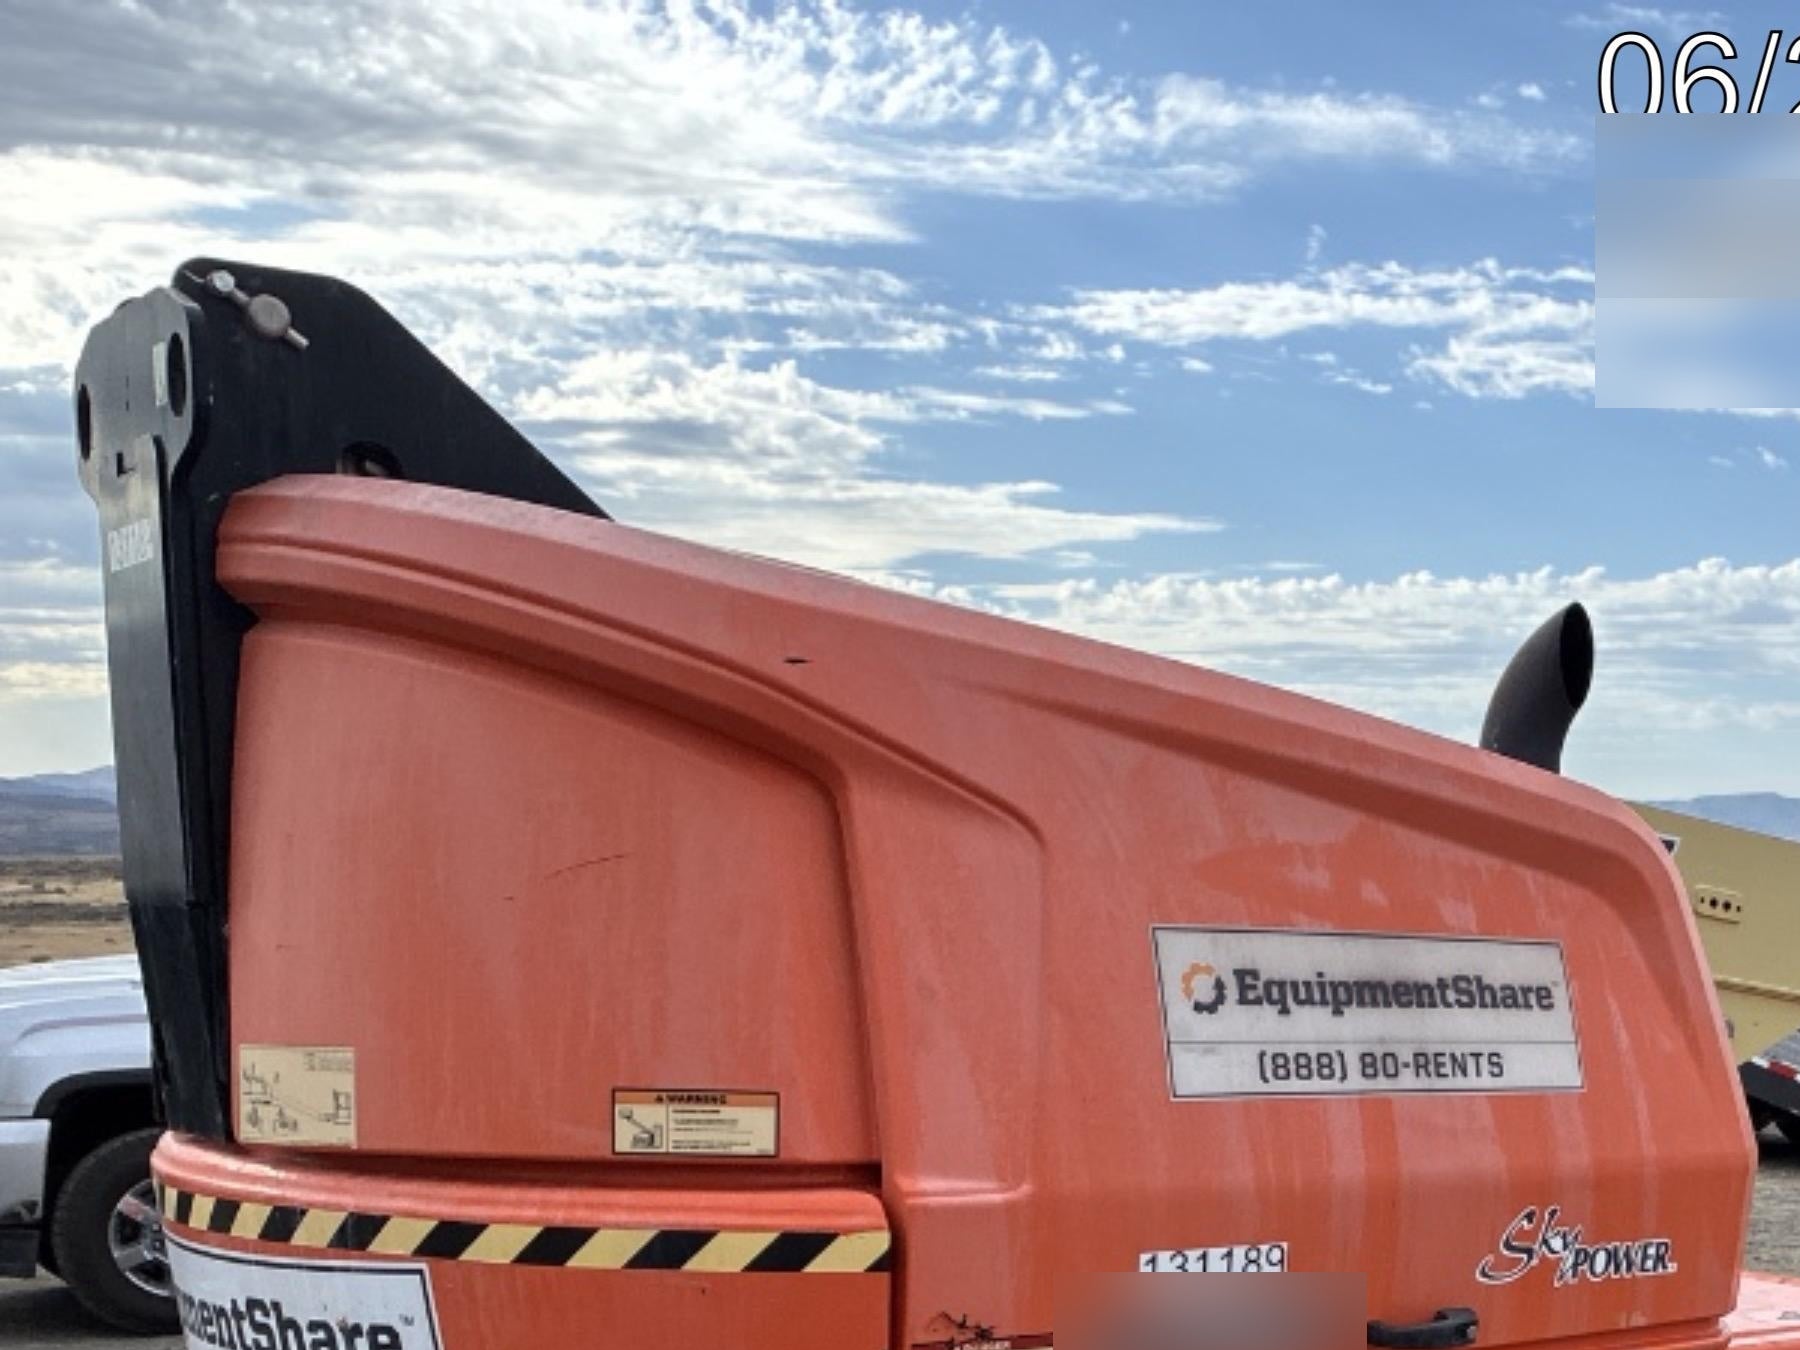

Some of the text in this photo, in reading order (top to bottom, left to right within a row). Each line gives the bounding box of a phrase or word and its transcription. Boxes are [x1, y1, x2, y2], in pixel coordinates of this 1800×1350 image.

[1232, 967, 1555, 1017] EquipmentShare
[1257, 1048, 1504, 1083] (888) 80-RENTS
[1476, 1205, 1670, 1288] Sky POWER
